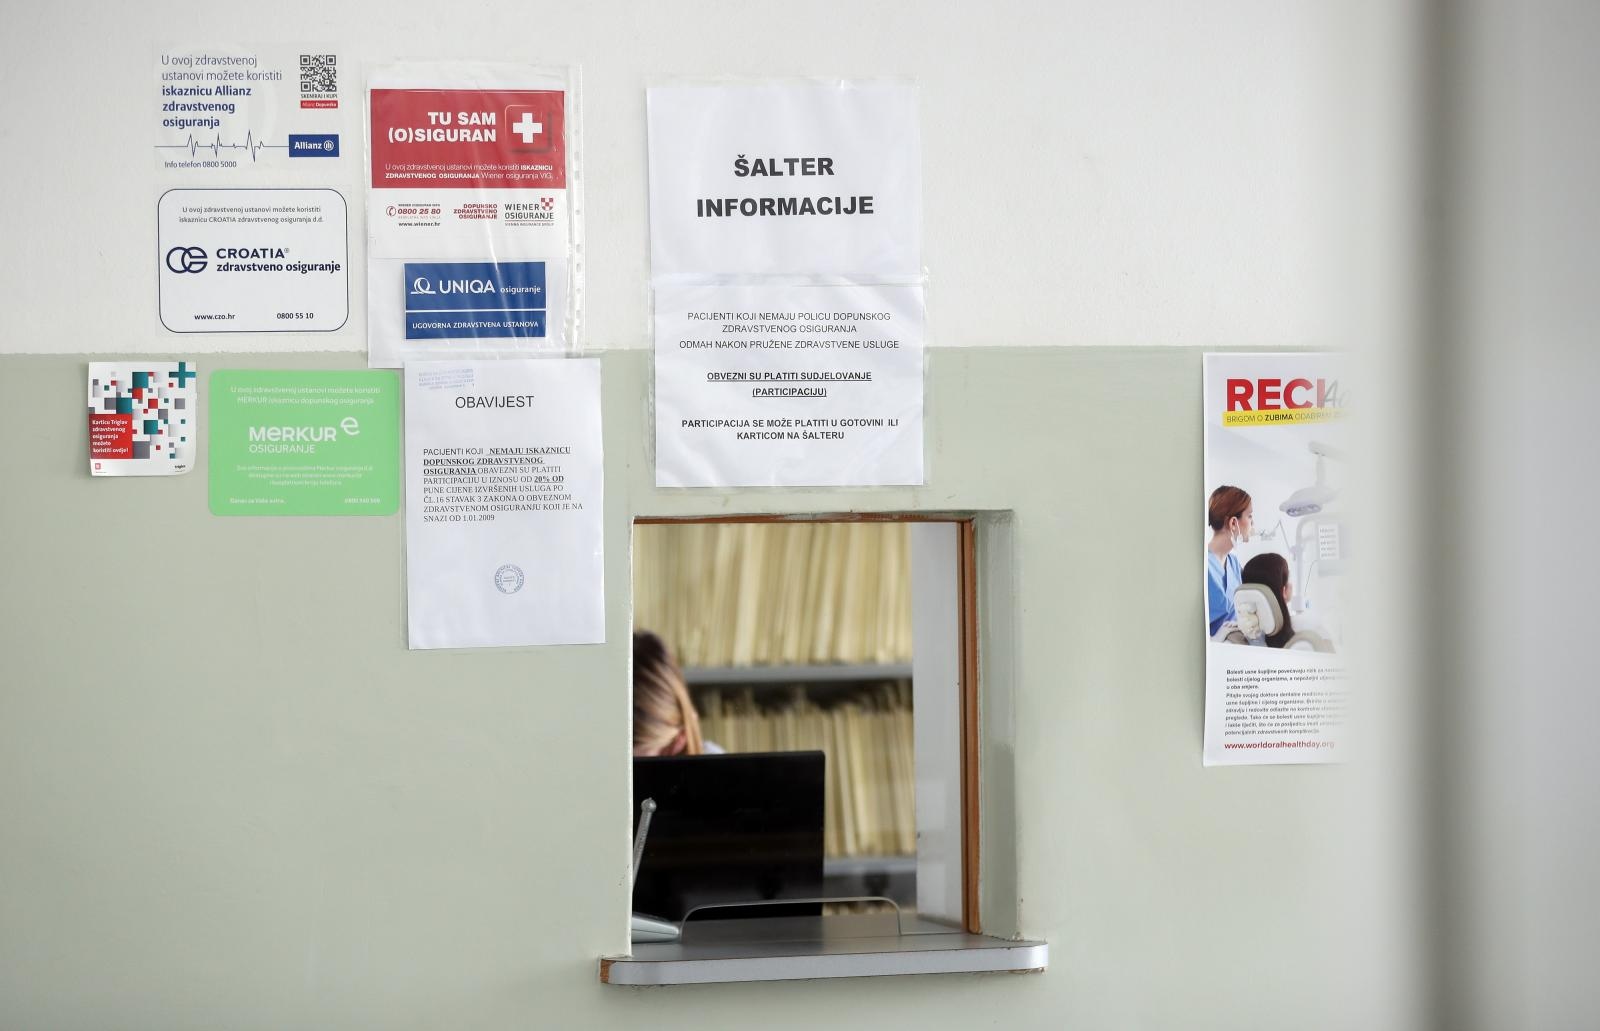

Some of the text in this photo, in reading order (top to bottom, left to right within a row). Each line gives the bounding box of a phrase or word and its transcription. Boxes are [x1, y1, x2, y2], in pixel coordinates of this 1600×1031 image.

[162, 54, 257, 68] U ovoj zdravstvenoj
[162, 70, 282, 80] ustanovi možete koristiti
[162, 86, 251, 96] iskaznicu Allianz
[163, 101, 235, 114] zdravstvenog
[163, 117, 220, 129] osiguranja
[428, 112, 496, 125] TU SAM
[388, 128, 496, 143] (O)SIGURAN
[295, 141, 322, 150] Allianz
[392, 164, 405, 172] ovoj
[407, 164, 445, 172] zdravstvenoj
[734, 154, 834, 177] ŠALTER
[697, 196, 874, 217] INFORMACIJE
[217, 261, 340, 274] zdravstveno osiguranje
[440, 280, 495, 293] UNIQA
[501, 286, 540, 295] osiguranje
[688, 313, 734, 321] PACIJENTI
[736, 313, 756, 321] KOJI
[722, 325, 857, 333] ZDRAVSTVENOG OSIGURANJA
[679, 341, 712, 349] ODMAH
[715, 341, 747, 349] NAKON
[750, 339, 793, 349] PRUŽENE
[863, 340, 899, 348] USLUGE
[707, 372, 872, 380] OBVEZNI SU PLATITI SUDJELOVANJE
[752, 388, 827, 397] (PARTICIPACIJU)
[456, 396, 534, 408] OBAVIJEST
[682, 420, 750, 428] PARTICIPACIJA
[753, 419, 764, 427] SE
[767, 418, 792, 427] MOŽE
[795, 419, 828, 427] PLATITI
[831, 419, 837, 427] U
[840, 419, 883, 427] GOTOVINI
[737, 432, 785, 440] KARTICOM
[802, 430, 844, 439] ŠALTERU
[250, 445, 315, 454] OSIGURANJE
[424, 448, 464, 456] PACIJENTI
[477, 457, 543, 465] ZDRAVSTVENOG
[424, 477, 480, 485] PARTICIPACIJU
[475, 485, 517, 493] IZVRŠENIH
[424, 505, 489, 513] ZDRAVSTVENOM
[1225, 741, 1334, 749] www.worldoralhealthday.org
